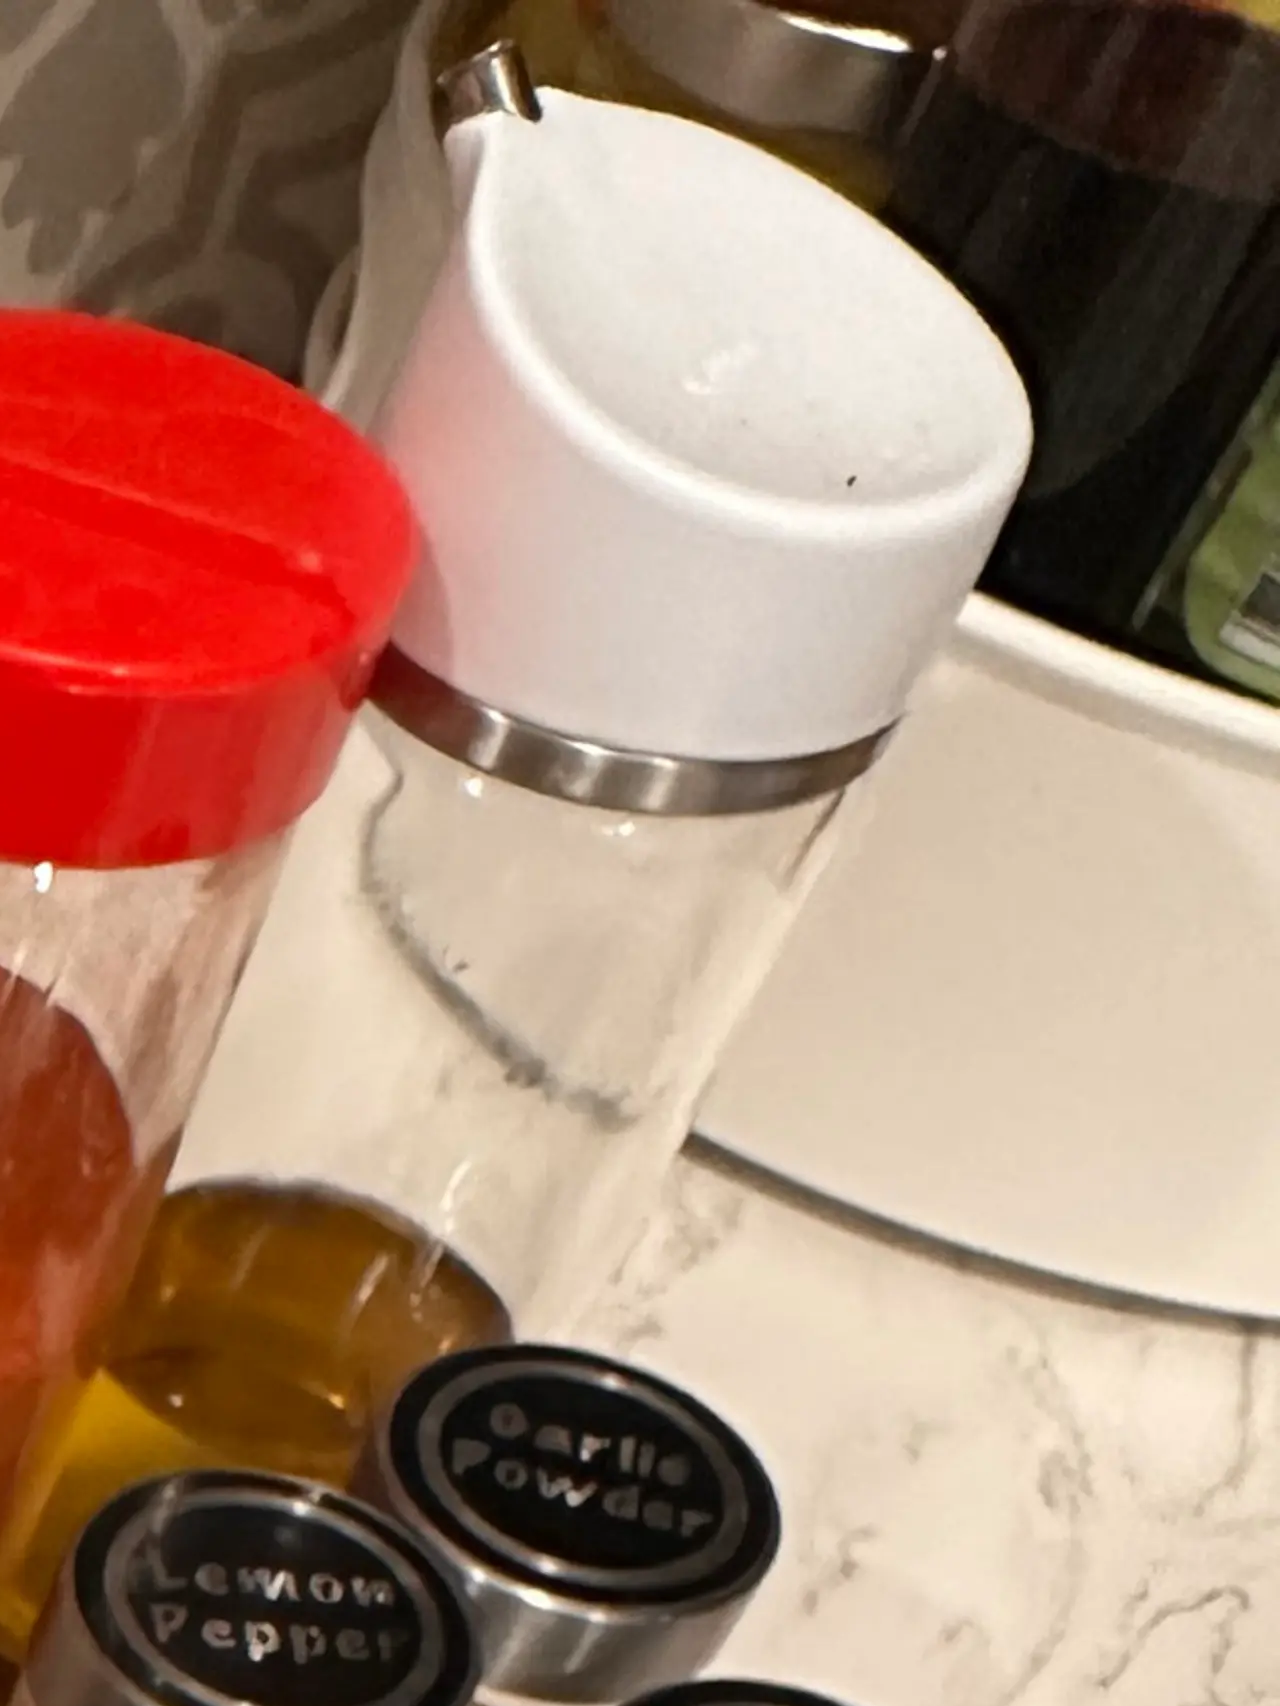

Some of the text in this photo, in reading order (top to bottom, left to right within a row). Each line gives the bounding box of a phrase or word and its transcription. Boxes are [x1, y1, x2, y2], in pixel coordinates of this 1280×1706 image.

[489, 1402, 691, 1487] Garlic
[451, 1436, 715, 1539] Powder
[144, 1542, 395, 1607] Lemon
[148, 1602, 408, 1665] Pepper
